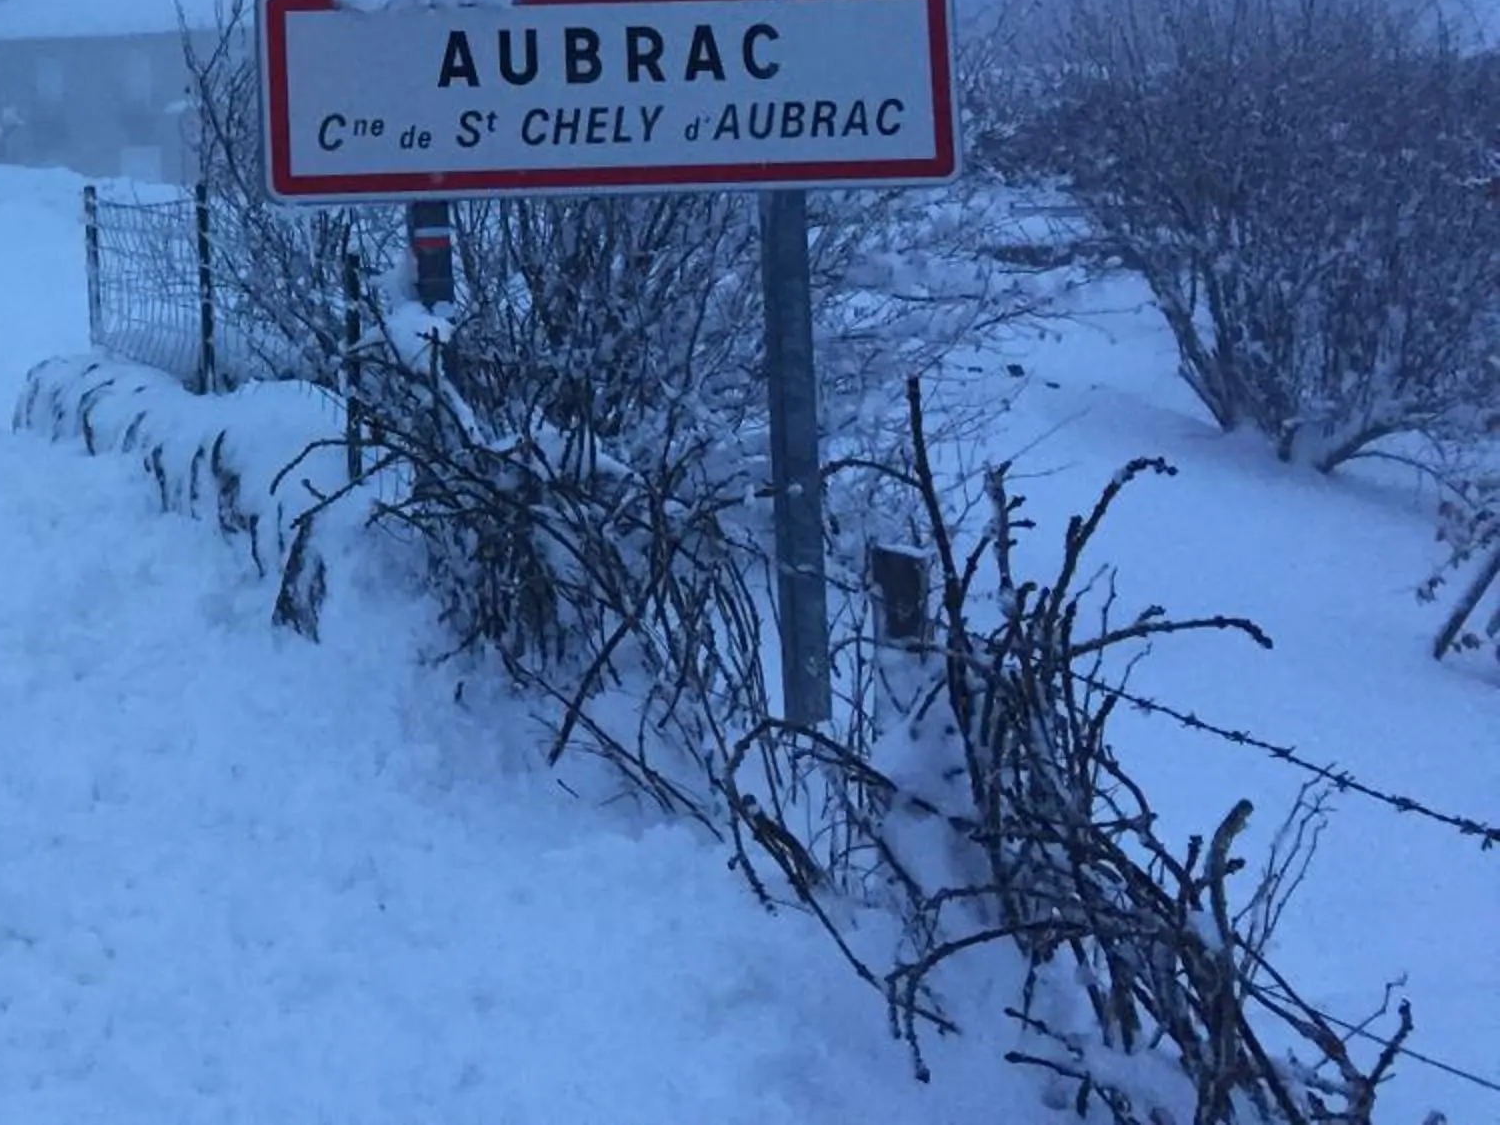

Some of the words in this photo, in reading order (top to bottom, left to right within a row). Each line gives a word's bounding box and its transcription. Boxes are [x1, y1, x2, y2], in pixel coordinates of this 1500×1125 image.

[437, 23, 781, 88] AUBRAC
[318, 113, 384, 151] Cne
[400, 124, 432, 150] de
[456, 110, 497, 149] St
[521, 105, 663, 146] CHELY
